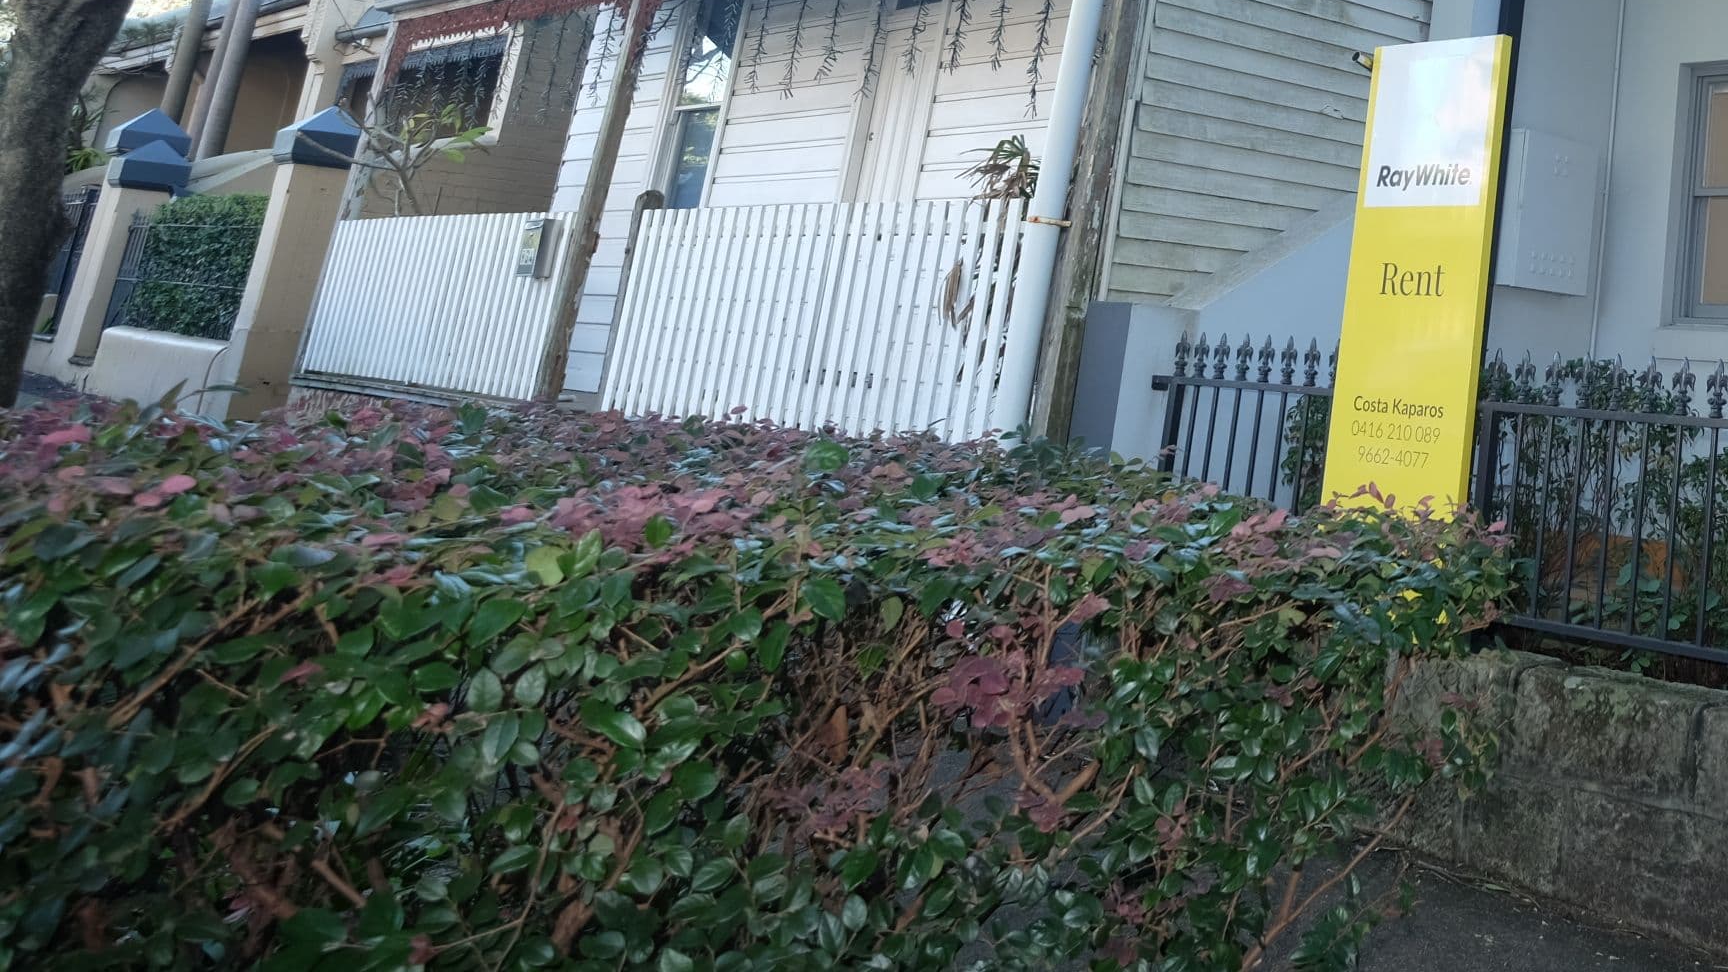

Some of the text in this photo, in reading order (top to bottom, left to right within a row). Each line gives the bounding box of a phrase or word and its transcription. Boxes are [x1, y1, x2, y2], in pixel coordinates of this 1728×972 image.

[1379, 262, 1446, 297] Rent
[1353, 395, 1444, 419] Costa Kaparos
[1351, 420, 1441, 445] 0416 210 089
[1358, 445, 1430, 469] 9662-4077
